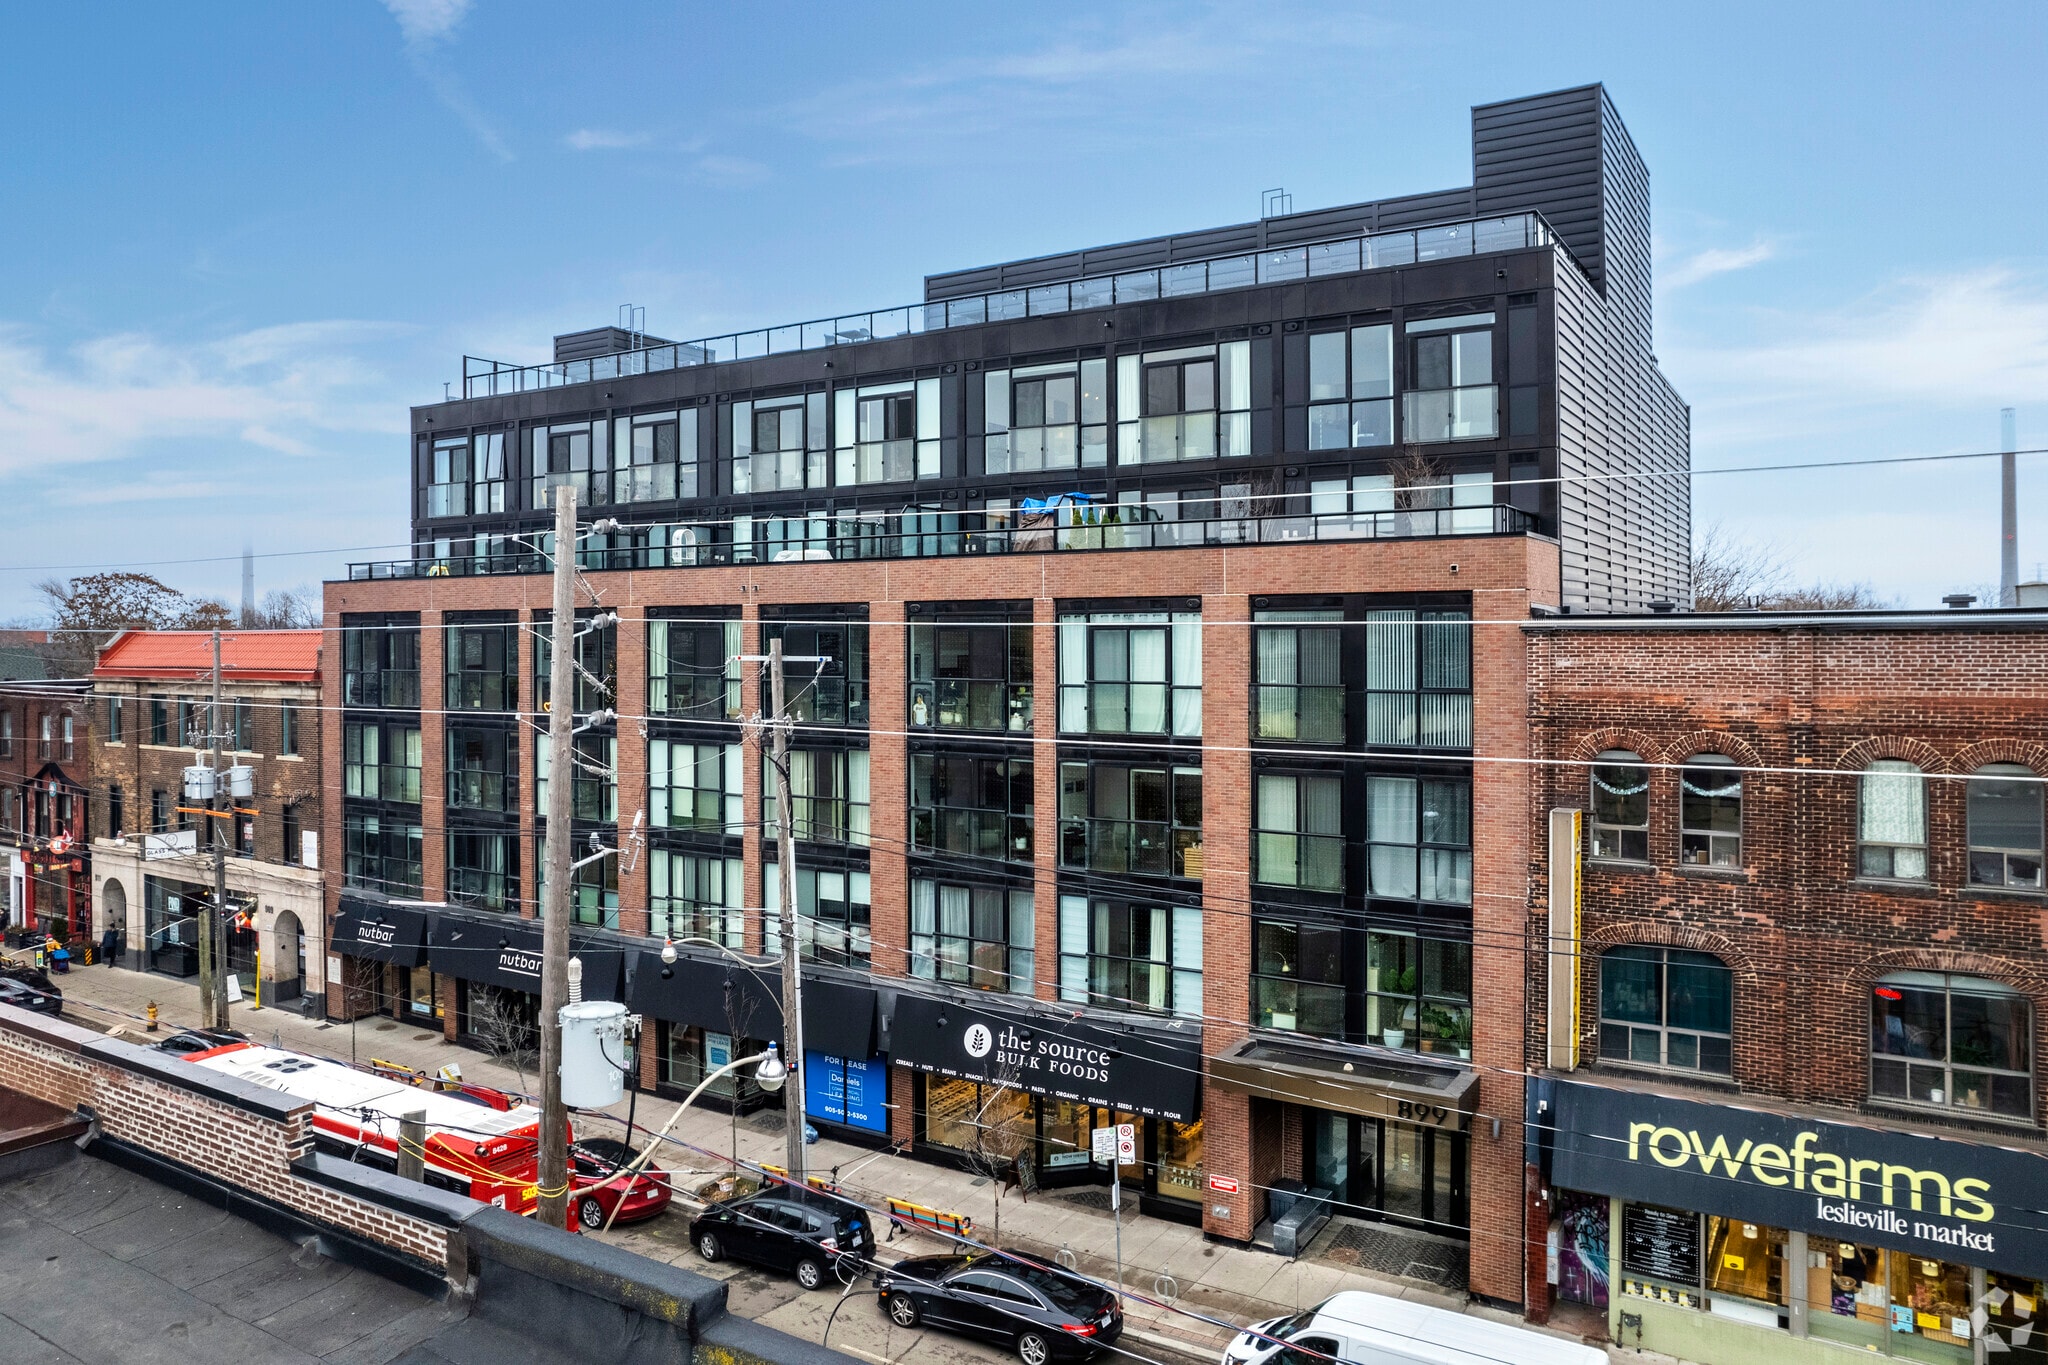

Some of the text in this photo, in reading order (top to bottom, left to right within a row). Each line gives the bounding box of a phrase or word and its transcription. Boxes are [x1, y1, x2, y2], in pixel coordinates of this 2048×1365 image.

[358, 925, 395, 942] nutbar
[499, 953, 543, 972] nutbar
[999, 1026, 1111, 1066] the source
[824, 1055, 867, 1071] FOR LEASE
[996, 1051, 1109, 1083] BULK FOODS
[896, 1059, 914, 1068] CEREALS
[921, 1063, 934, 1072] NUTS
[941, 1068, 957, 1076] BEANS
[965, 1073, 984, 1082] SNACKS
[1031, 1085, 1046, 1094] PASTA
[1055, 1090, 1079, 1101] ORGANIC
[1087, 1096, 1108, 1106] GRAINS
[1117, 1102, 1133, 1111] SEEDS
[1142, 1106, 1154, 1115] RICE
[1163, 1111, 1181, 1120] FLOUR
[1398, 1100, 1448, 1125] 899
[1628, 1121, 1995, 1222] rowefarms
[1817, 1197, 1995, 1253] leslieville market
